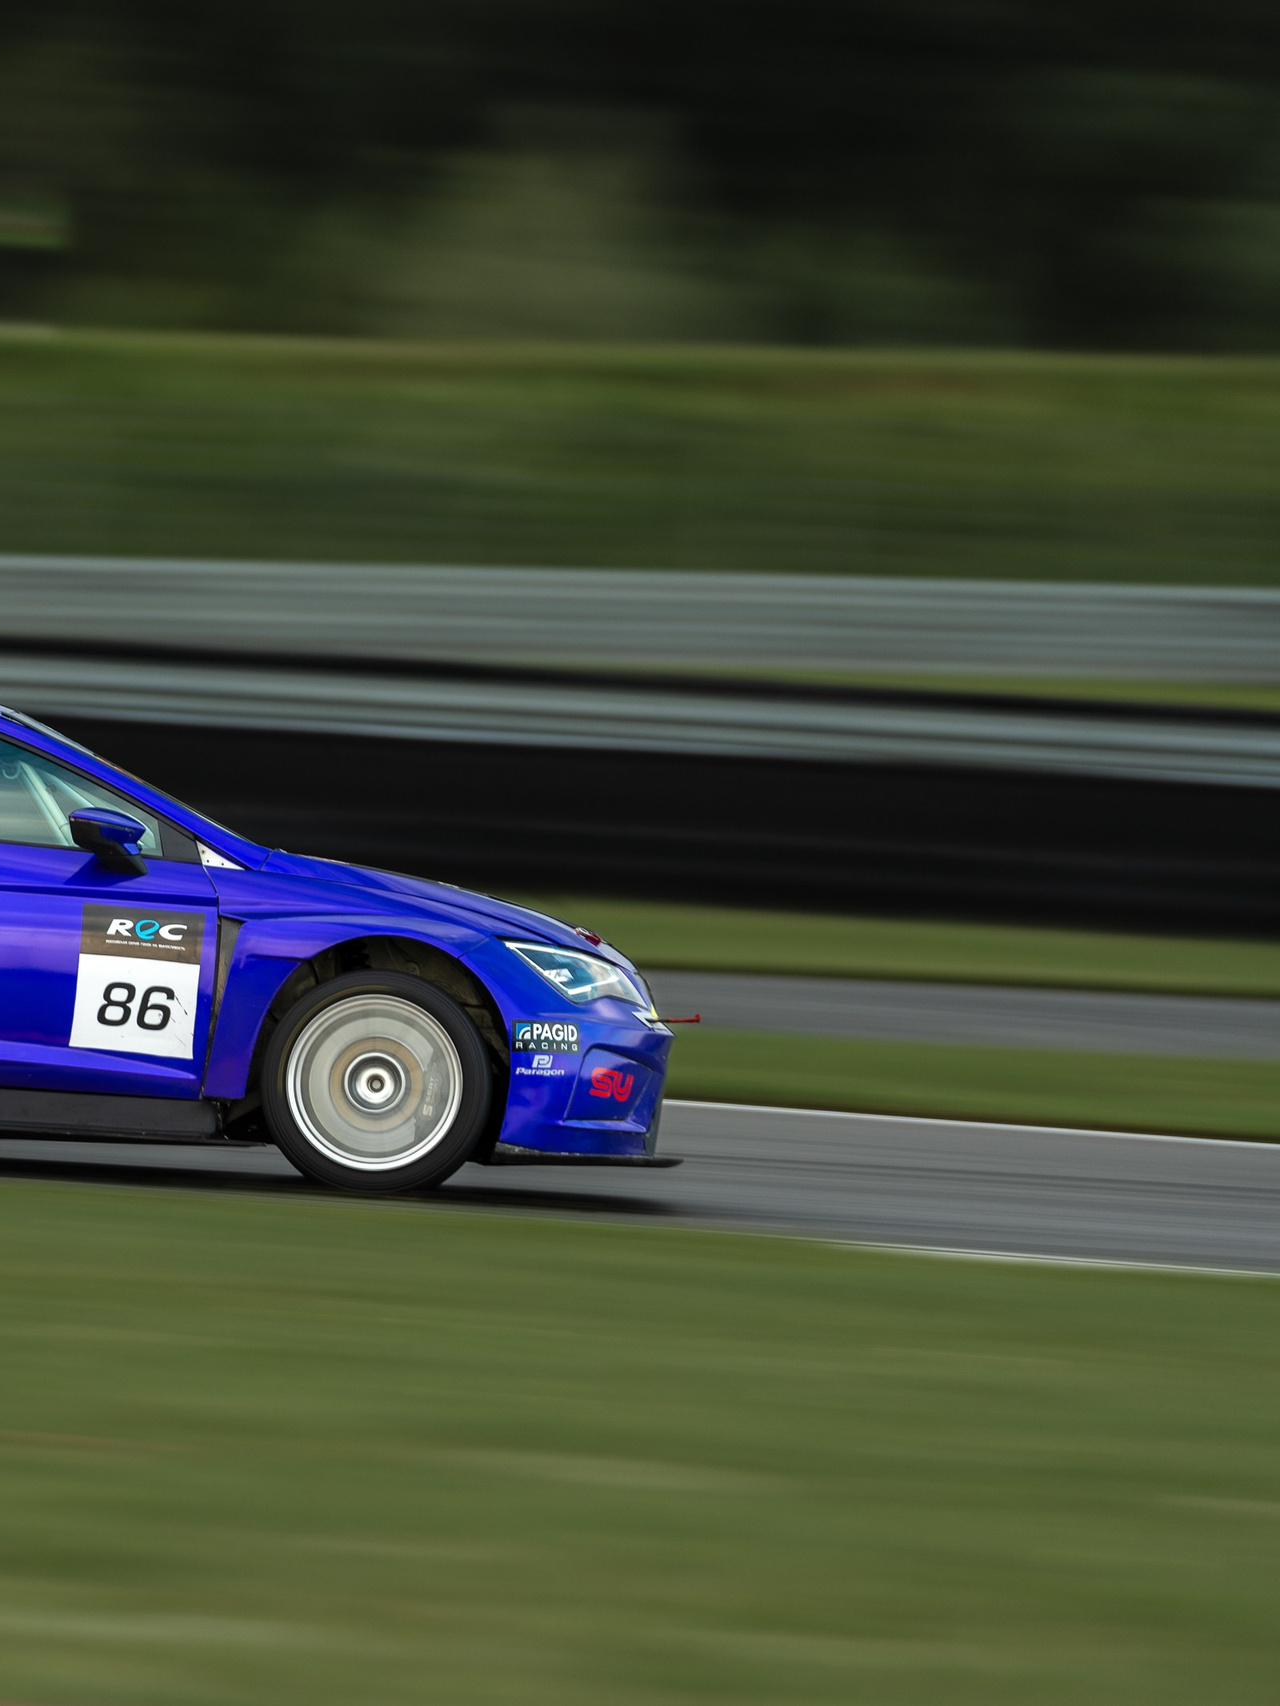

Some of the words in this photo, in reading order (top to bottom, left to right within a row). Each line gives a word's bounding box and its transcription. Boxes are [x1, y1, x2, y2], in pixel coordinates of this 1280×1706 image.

[97, 981, 175, 1031] 86
[532, 1023, 578, 1042] PAGID
[515, 1041, 579, 1052] RACING
[515, 1067, 565, 1077] Paragon
[589, 1067, 635, 1102] SU
